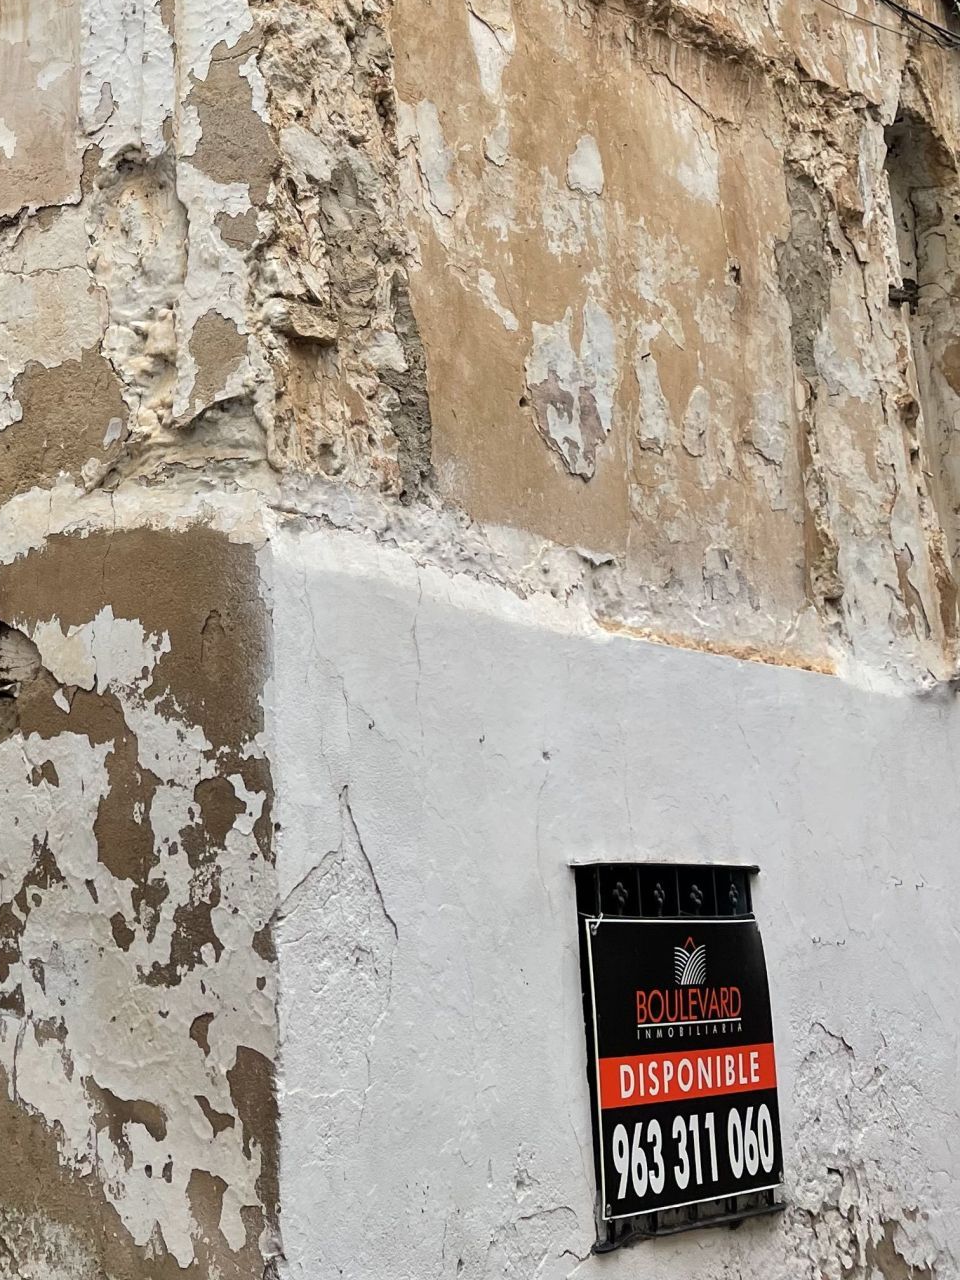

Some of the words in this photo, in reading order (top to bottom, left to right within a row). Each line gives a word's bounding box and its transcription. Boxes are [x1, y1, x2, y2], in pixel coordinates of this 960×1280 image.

[636, 986, 741, 1023] BOULEVARD
[637, 1023, 742, 1040] INMOBILIARIA
[619, 1051, 760, 1099] DISPONIBLE
[612, 1119, 665, 1200] 963
[672, 1112, 719, 1190] 311
[728, 1103, 774, 1179] 060
